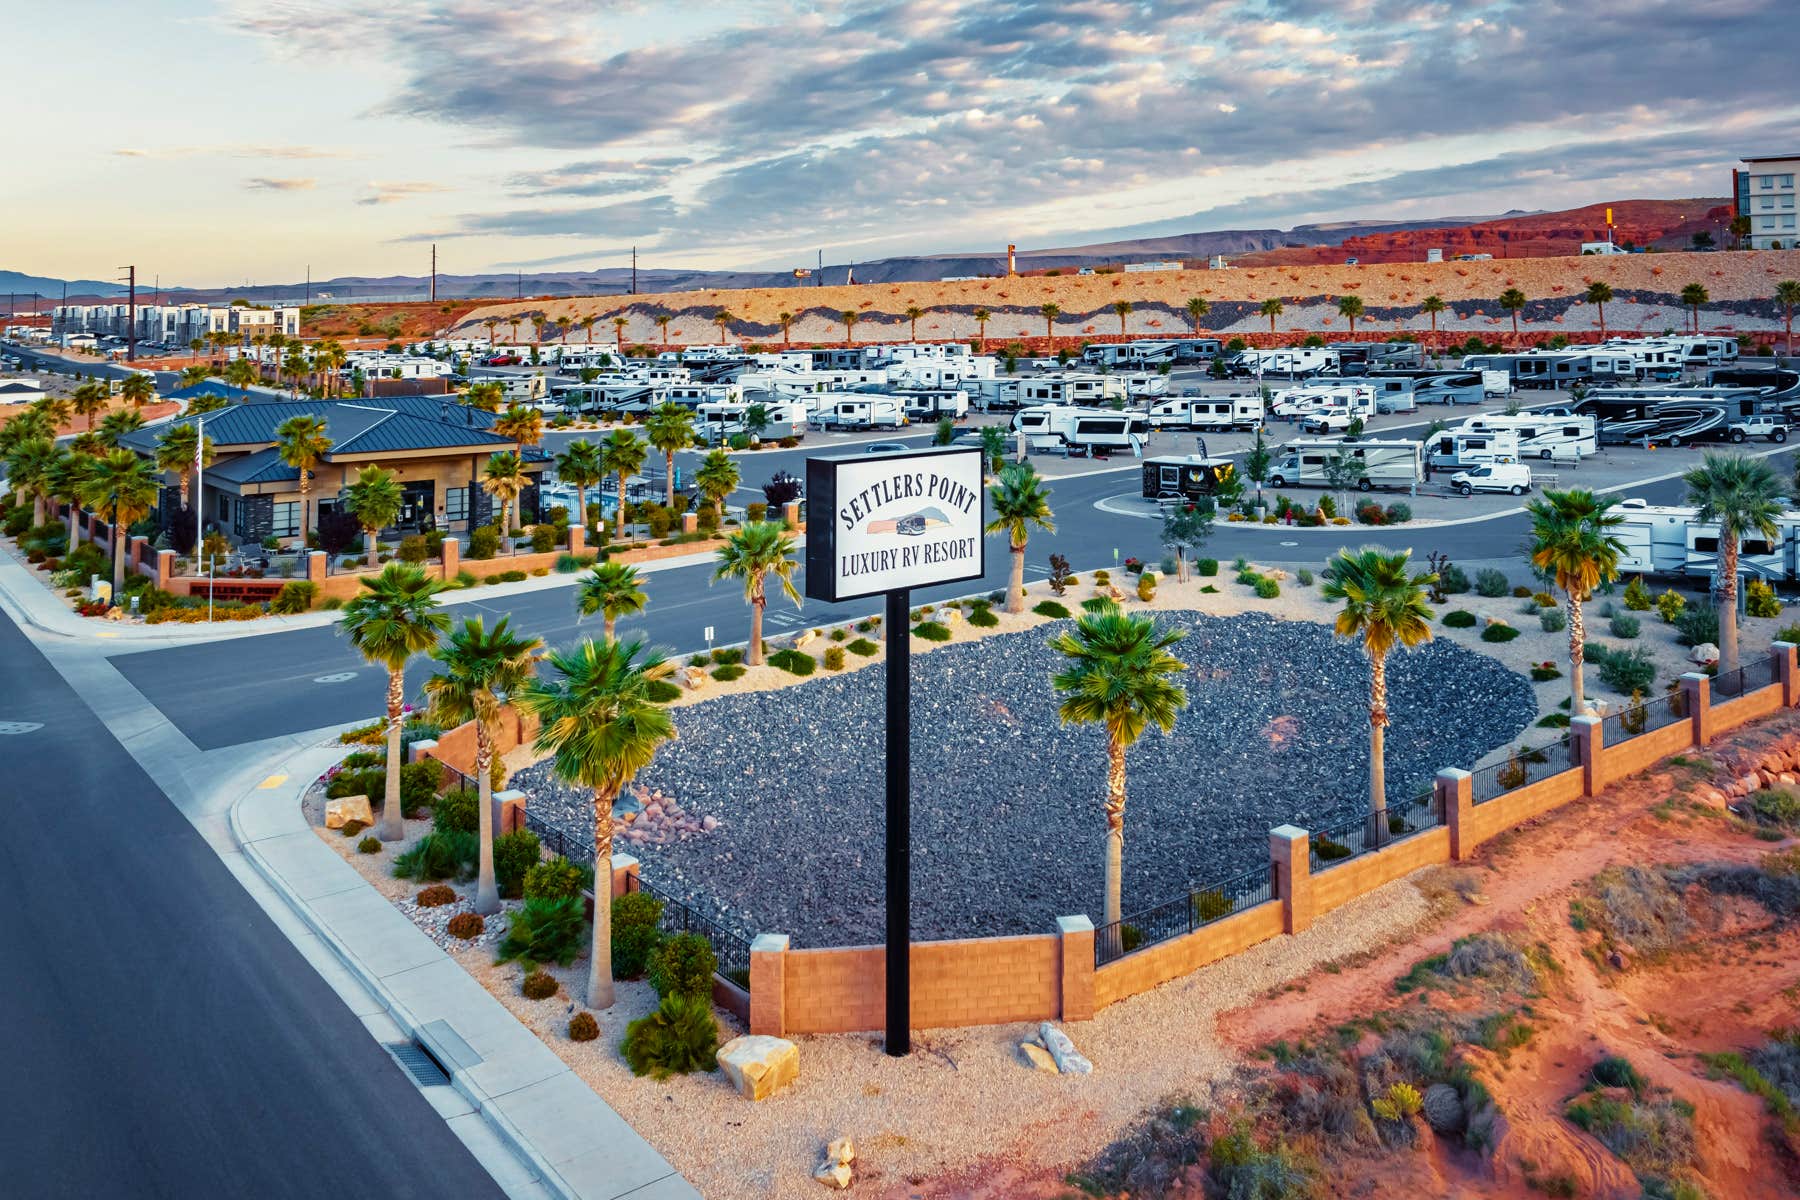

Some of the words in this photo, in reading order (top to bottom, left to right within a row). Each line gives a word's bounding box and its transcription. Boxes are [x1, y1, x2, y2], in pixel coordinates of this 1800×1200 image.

[840, 473, 923, 531] SETTLERS
[927, 474, 977, 514] POINT
[842, 548, 898, 577] LUXURY
[902, 545, 920, 567] RV
[924, 537, 975, 564] RESORT
